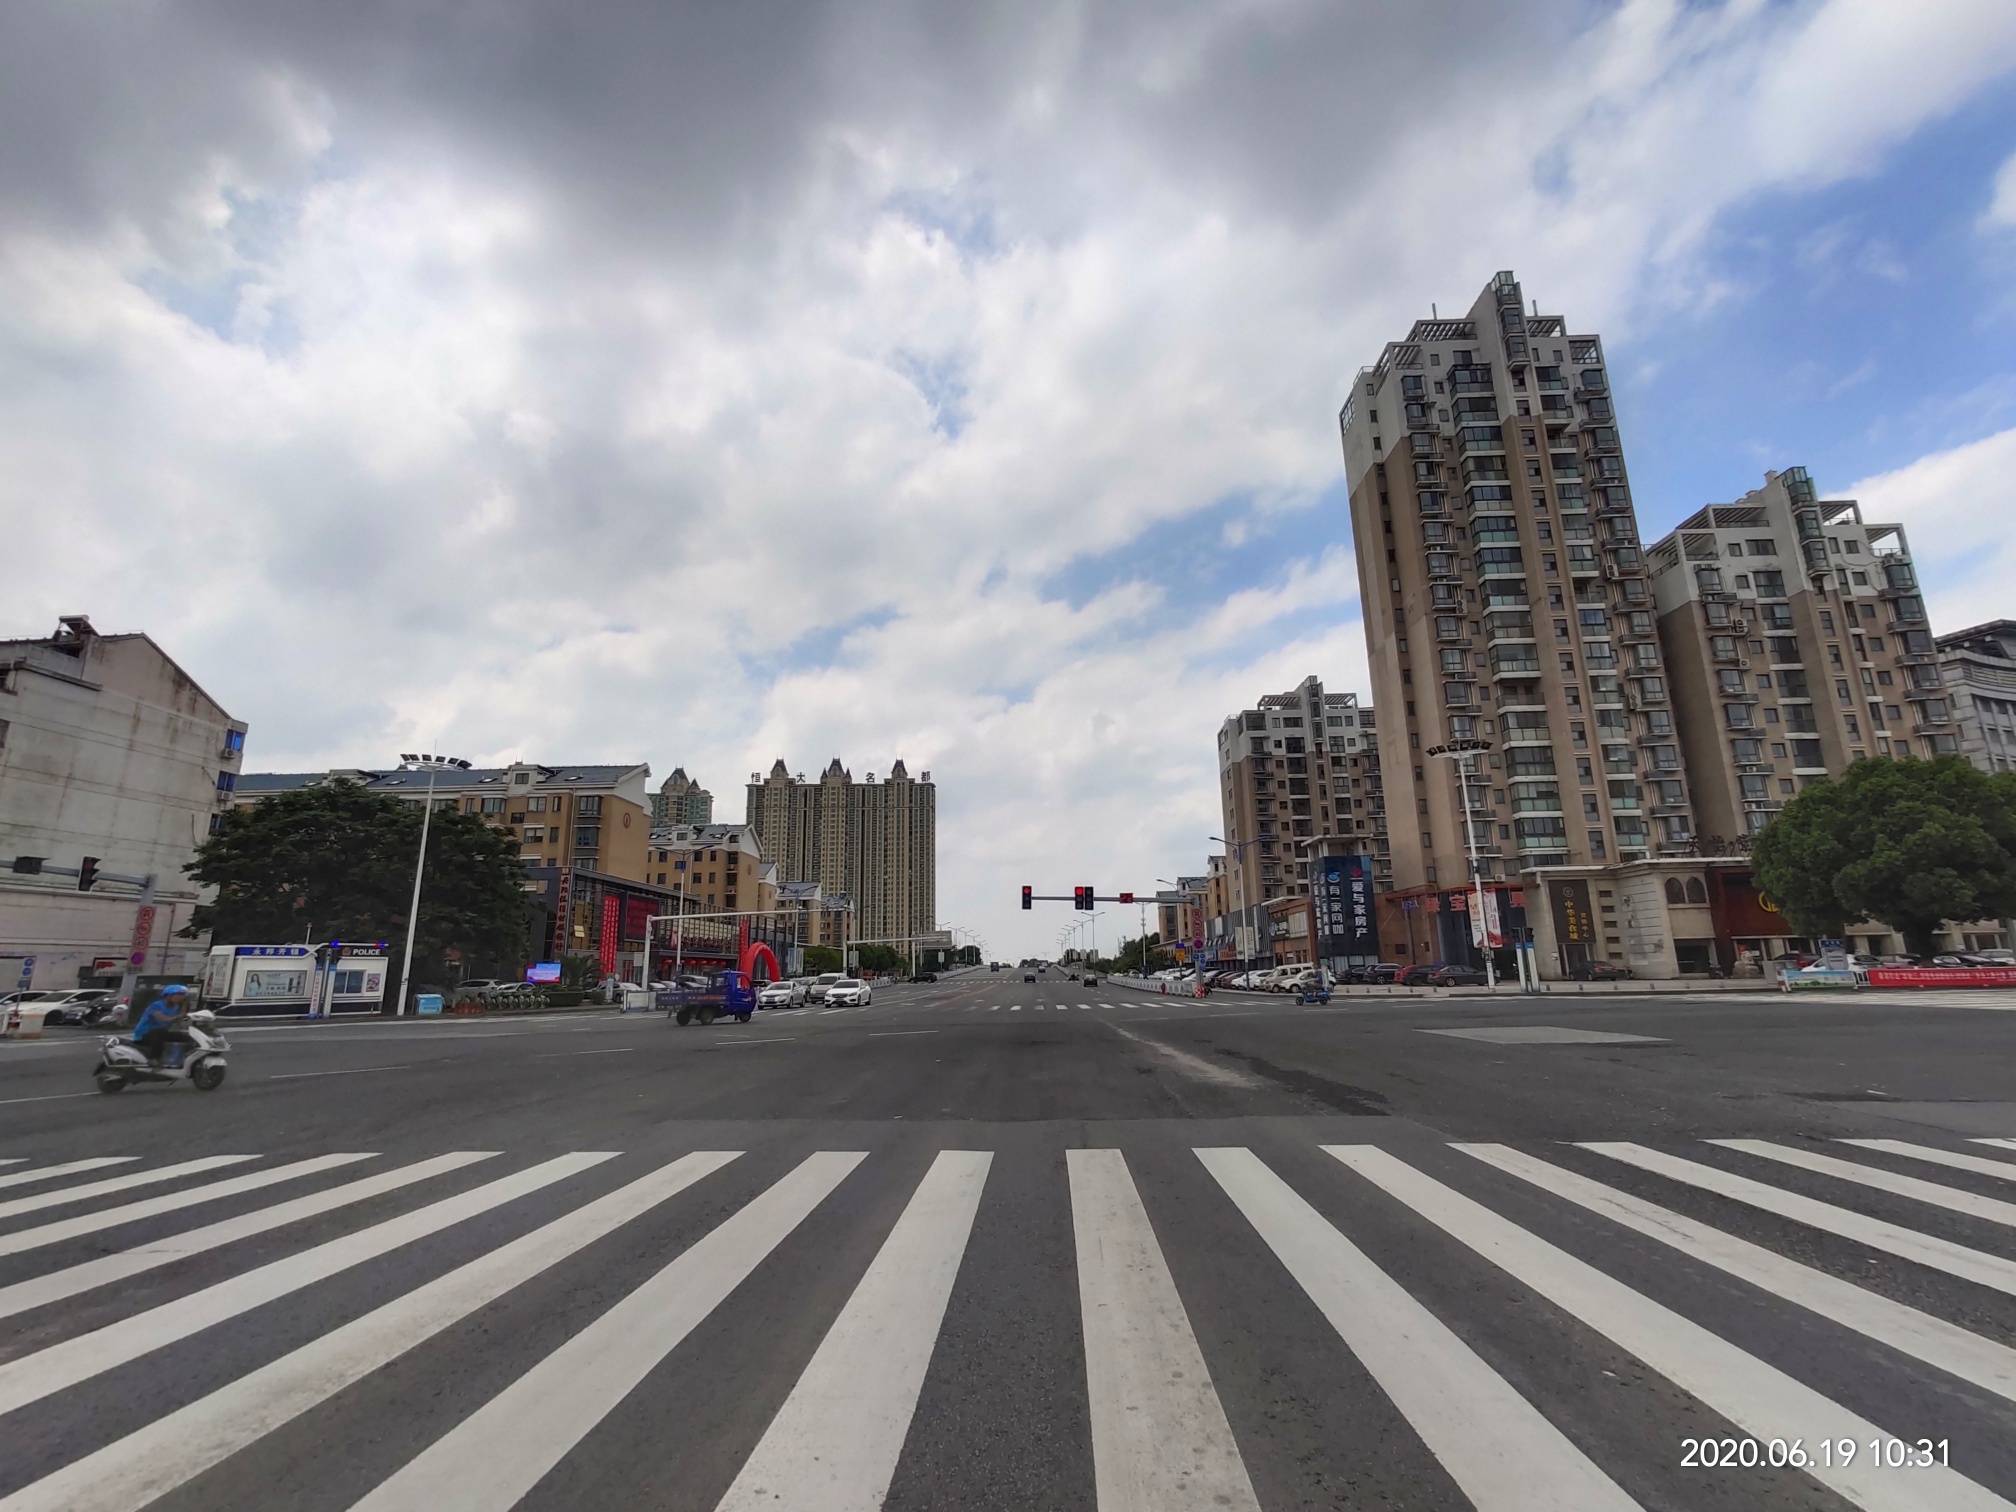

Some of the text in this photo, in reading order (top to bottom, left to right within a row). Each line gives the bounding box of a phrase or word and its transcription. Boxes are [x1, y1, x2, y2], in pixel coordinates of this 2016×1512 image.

[751, 771, 931, 784] 恒大名都
[1329, 885, 1344, 934] 有一家网咖
[1351, 881, 1368, 939] 爱与家房产
[352, 948, 381, 956] POLICE
